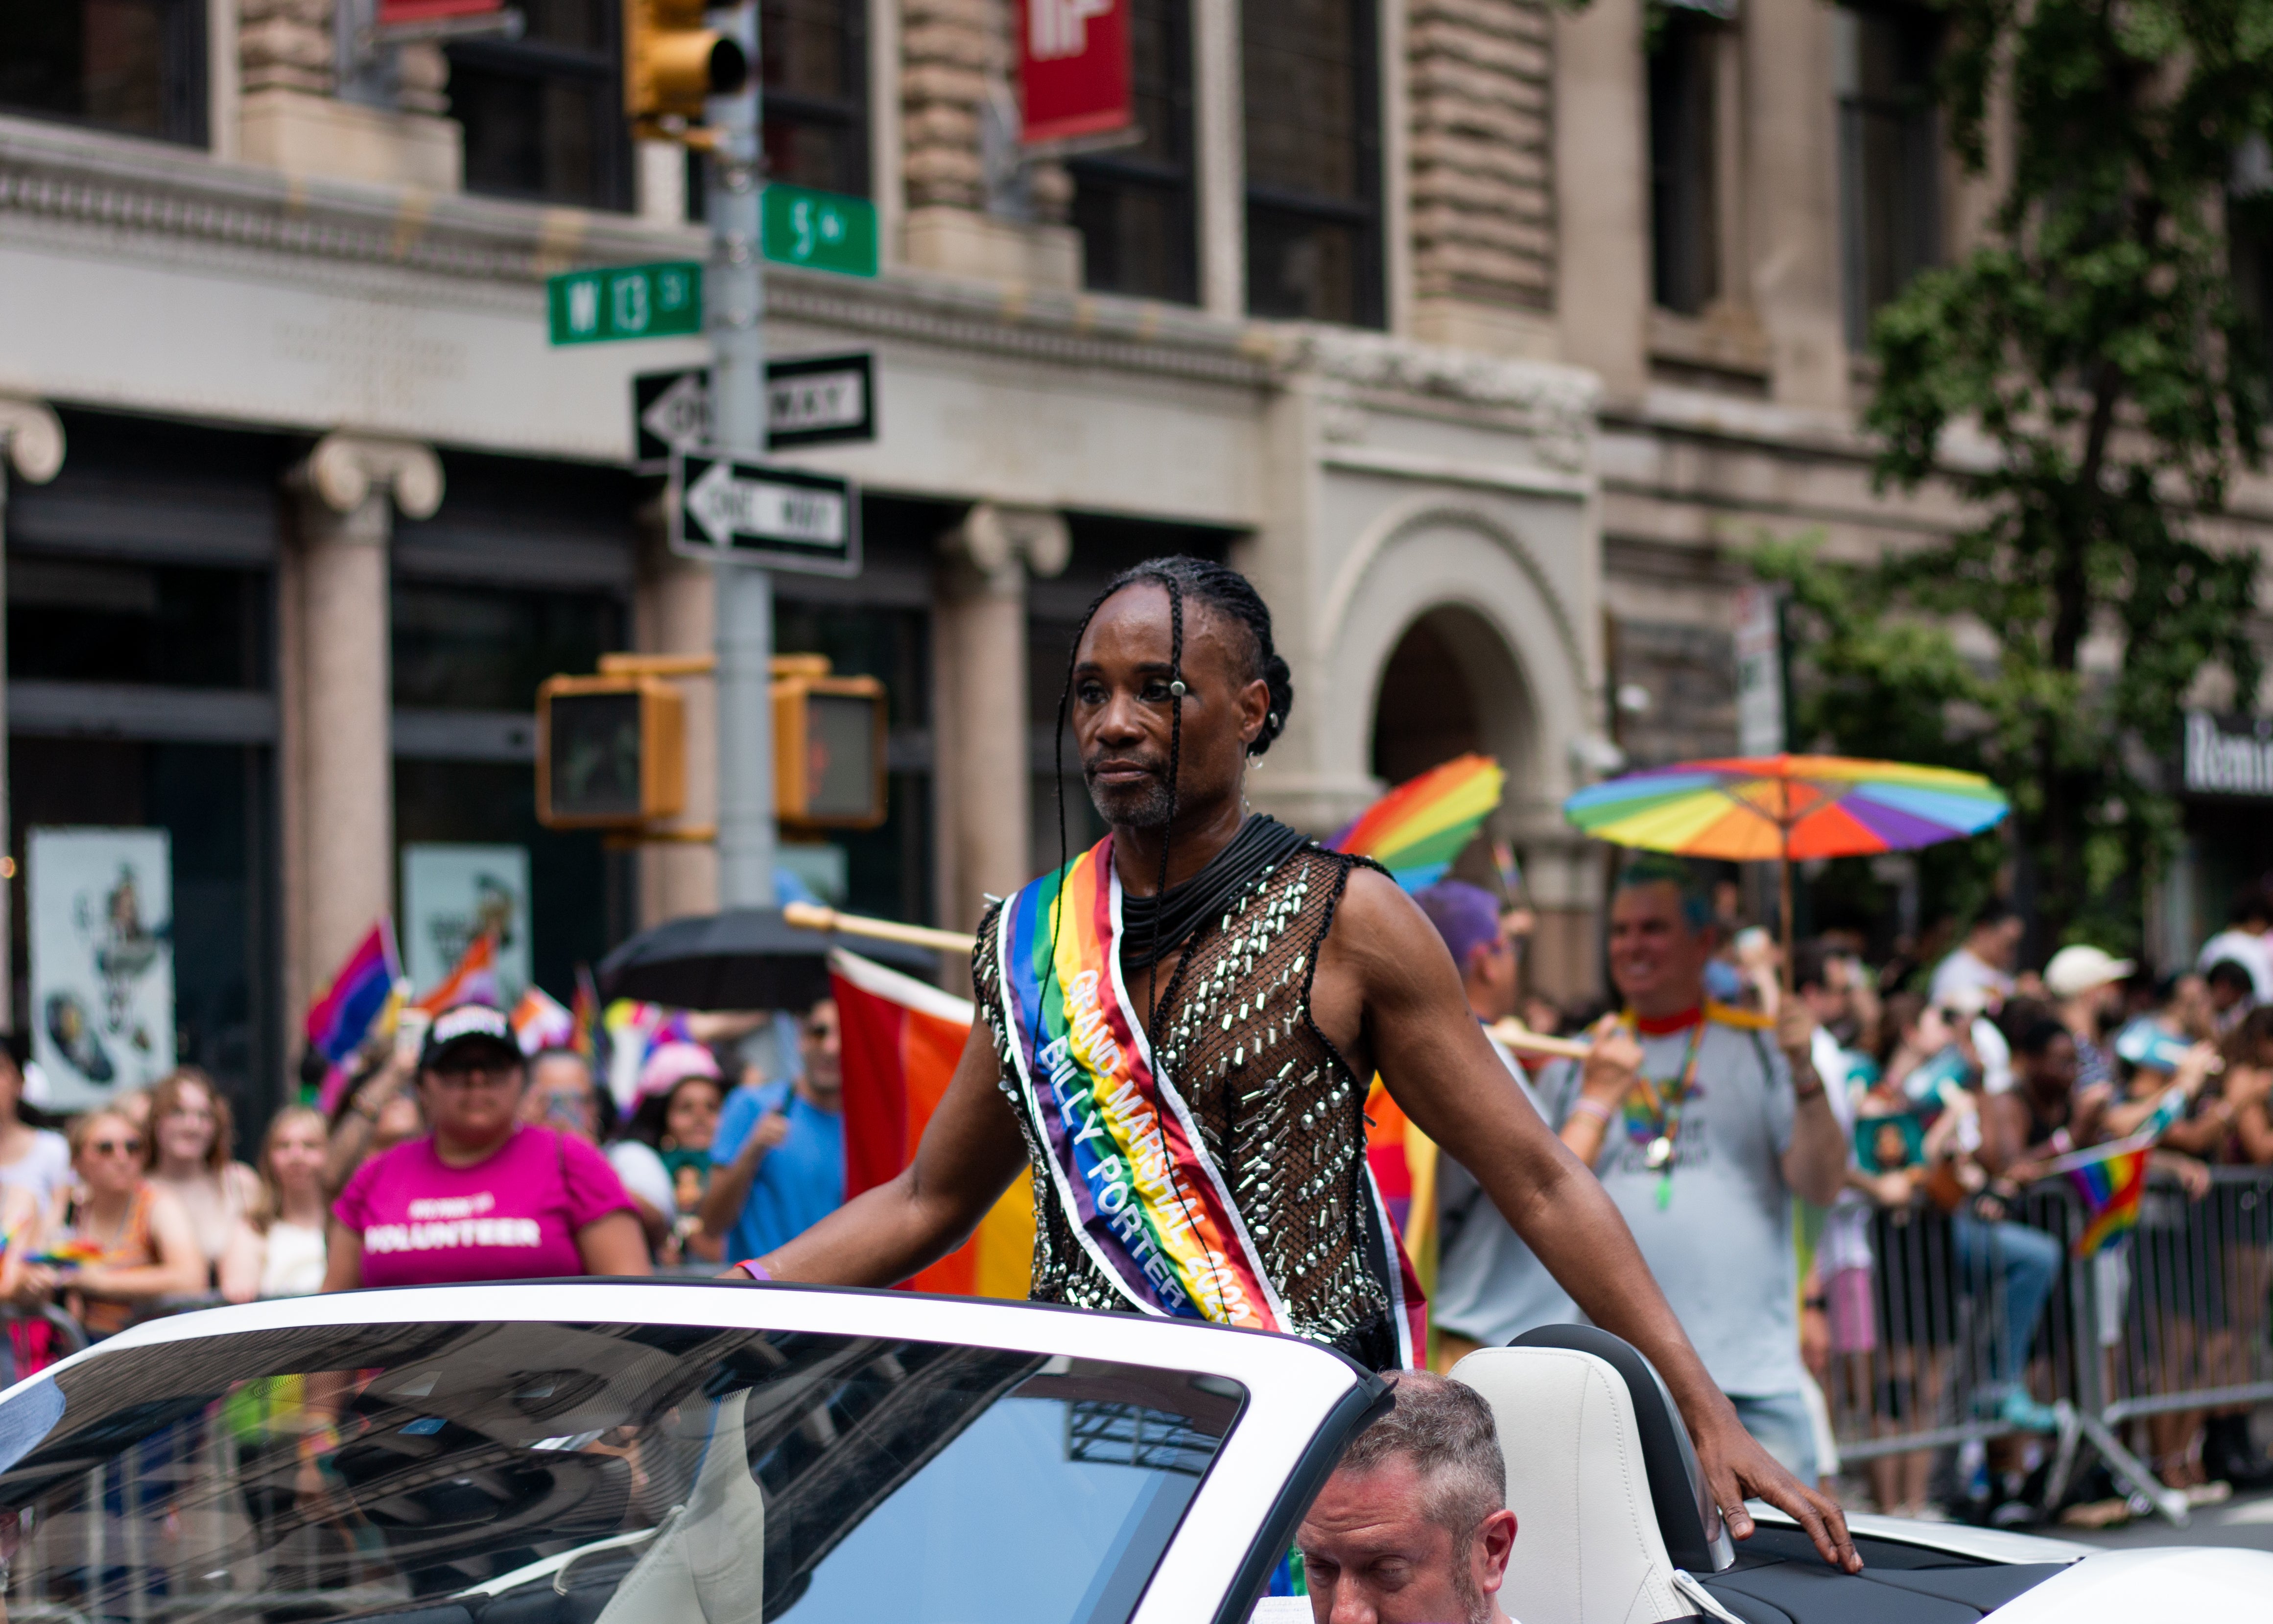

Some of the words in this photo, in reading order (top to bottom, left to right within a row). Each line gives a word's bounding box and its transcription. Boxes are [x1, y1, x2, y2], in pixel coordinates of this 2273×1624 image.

[791, 198, 813, 257] 5
[567, 279, 600, 332] W
[706, 483, 755, 525] ONE
[782, 494, 829, 530] WAY
[1068, 969, 1121, 1078] GRAND
[1106, 1079, 1205, 1247] MARSHAL
[1039, 1035, 1104, 1146] BILLY
[1088, 1153, 1186, 1309] PORTER
[365, 1218, 541, 1254] VOLUNTEER
